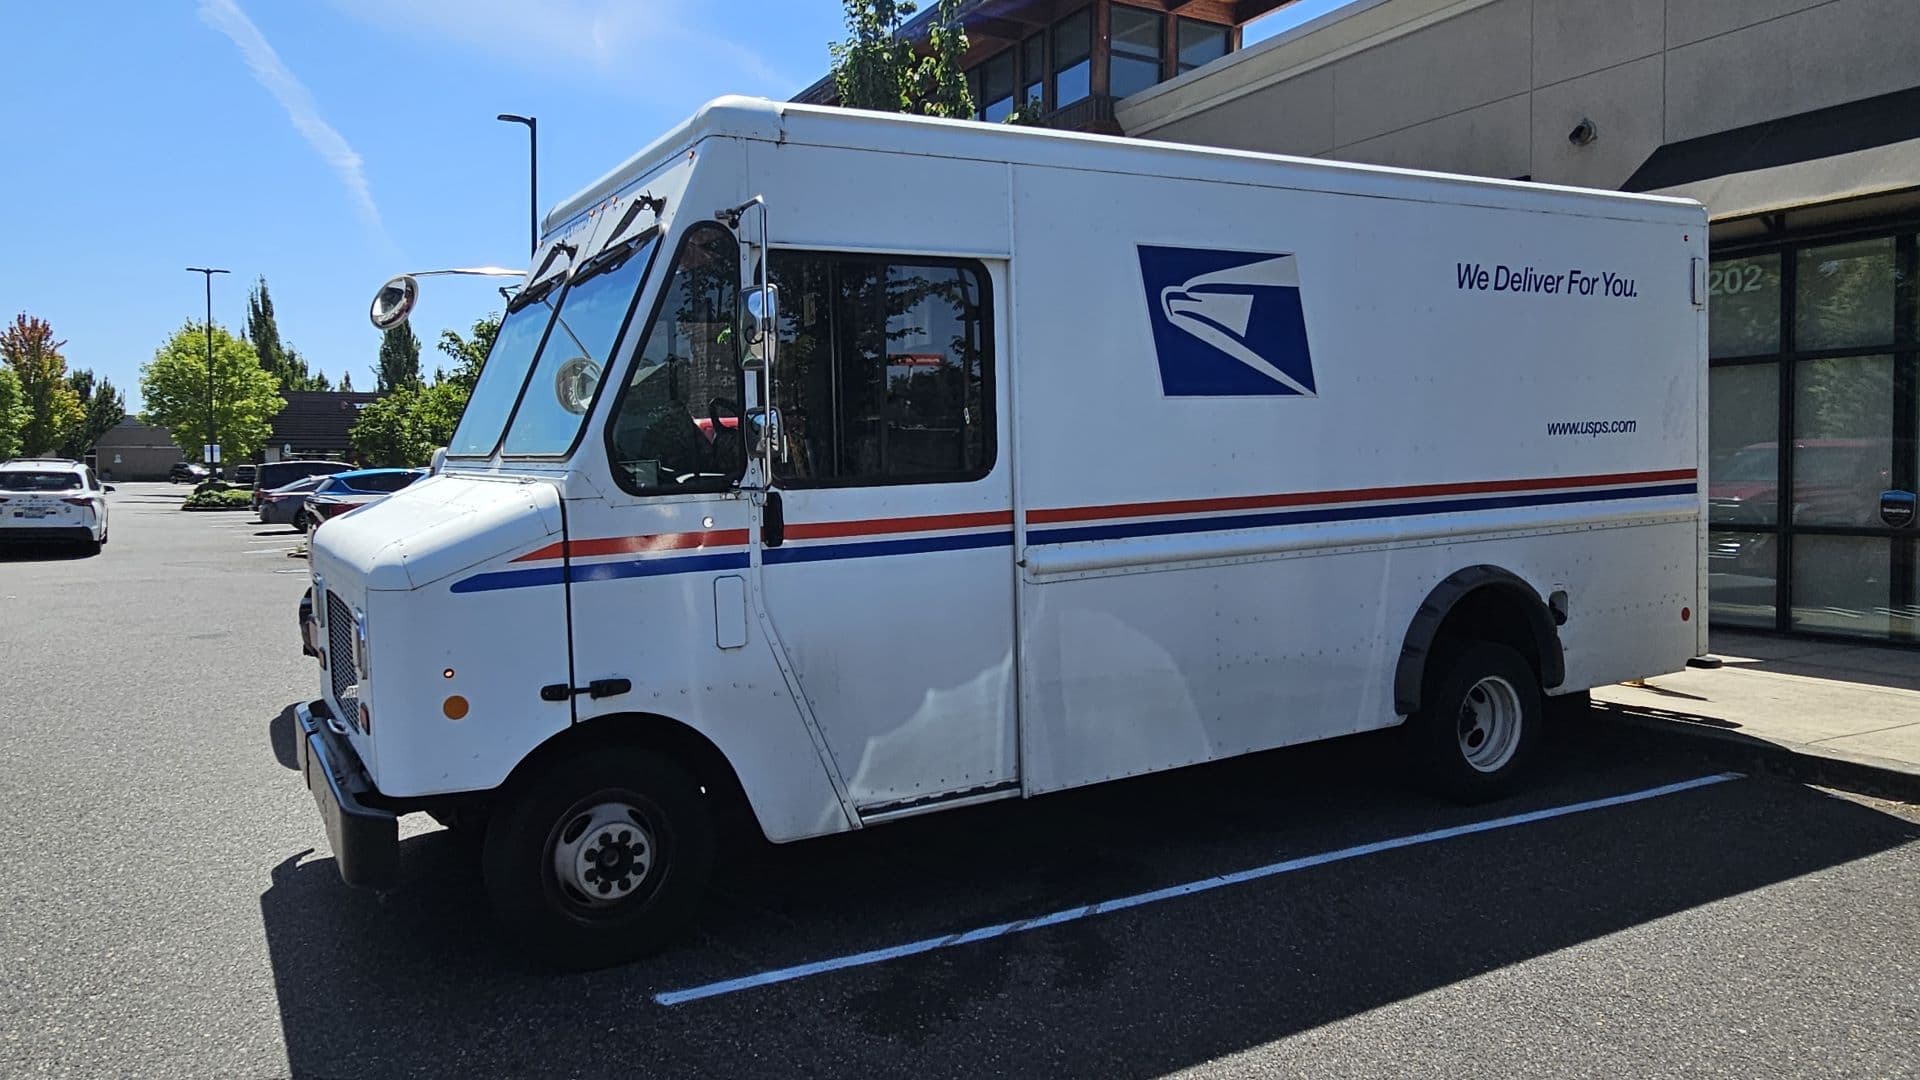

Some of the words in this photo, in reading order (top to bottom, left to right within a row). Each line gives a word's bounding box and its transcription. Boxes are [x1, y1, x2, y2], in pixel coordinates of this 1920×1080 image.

[1457, 262, 1489, 290] We
[1493, 265, 1564, 294] Deliver
[1567, 269, 1599, 296] For
[1602, 271, 1638, 298] You.
[1711, 264, 1762, 296] 202
[1547, 420, 1637, 438] www.usps.com
